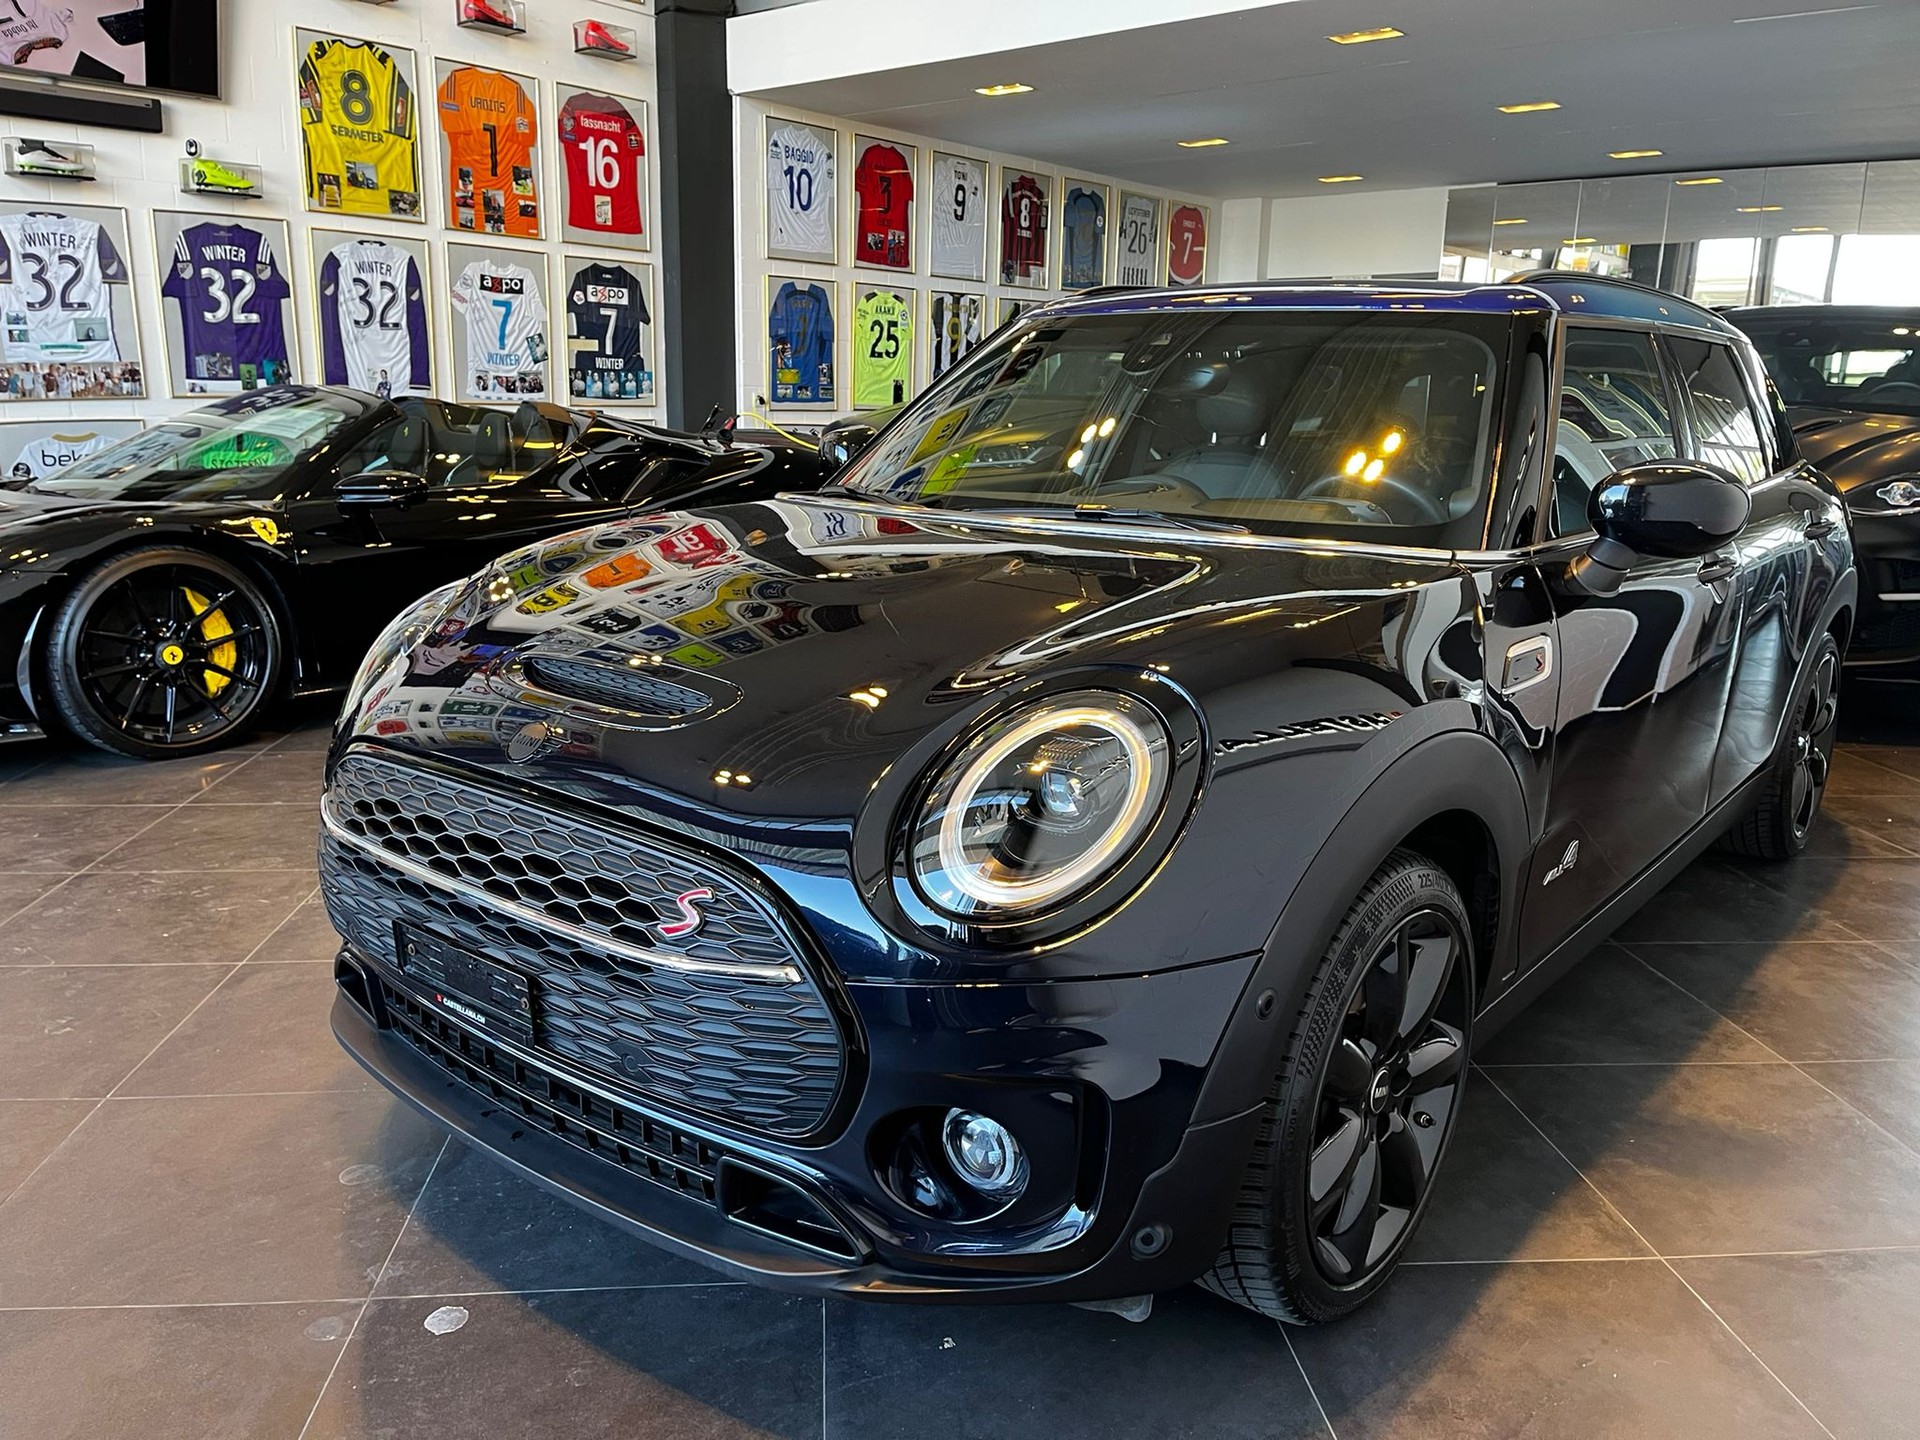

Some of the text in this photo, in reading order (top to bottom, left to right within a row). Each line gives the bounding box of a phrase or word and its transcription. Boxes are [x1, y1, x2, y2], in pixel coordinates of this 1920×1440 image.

[340, 69, 374, 125] 8
[331, 123, 384, 145] SERMETER
[482, 122, 497, 177] 1
[579, 135, 620, 189] 16
[784, 145, 814, 164] BAGGIO
[783, 165, 813, 212] 10
[954, 183, 967, 221] 9
[1020, 198, 1030, 228] 8
[24, 232, 76, 249] WINTER
[202, 245, 246, 263] WINTER
[1128, 220, 1147, 255] 26
[1183, 232, 1193, 265] 7
[22, 253, 92, 311] 32
[354, 261, 393, 277] WINTER
[201, 267, 261, 323] 32
[352, 278, 402, 331] 32
[492, 299, 512, 350] 7
[600, 308, 617, 355] 7
[870, 320, 899, 358] 25
[947, 316, 962, 353] 9
[487, 352, 521, 367] WINTER
[595, 357, 624, 370] WINTER
[41, 449, 91, 467] bek
[514, 732, 542, 748] MINI
[656, 886, 715, 939] S
[1374, 1085, 1389, 1099] MINI
